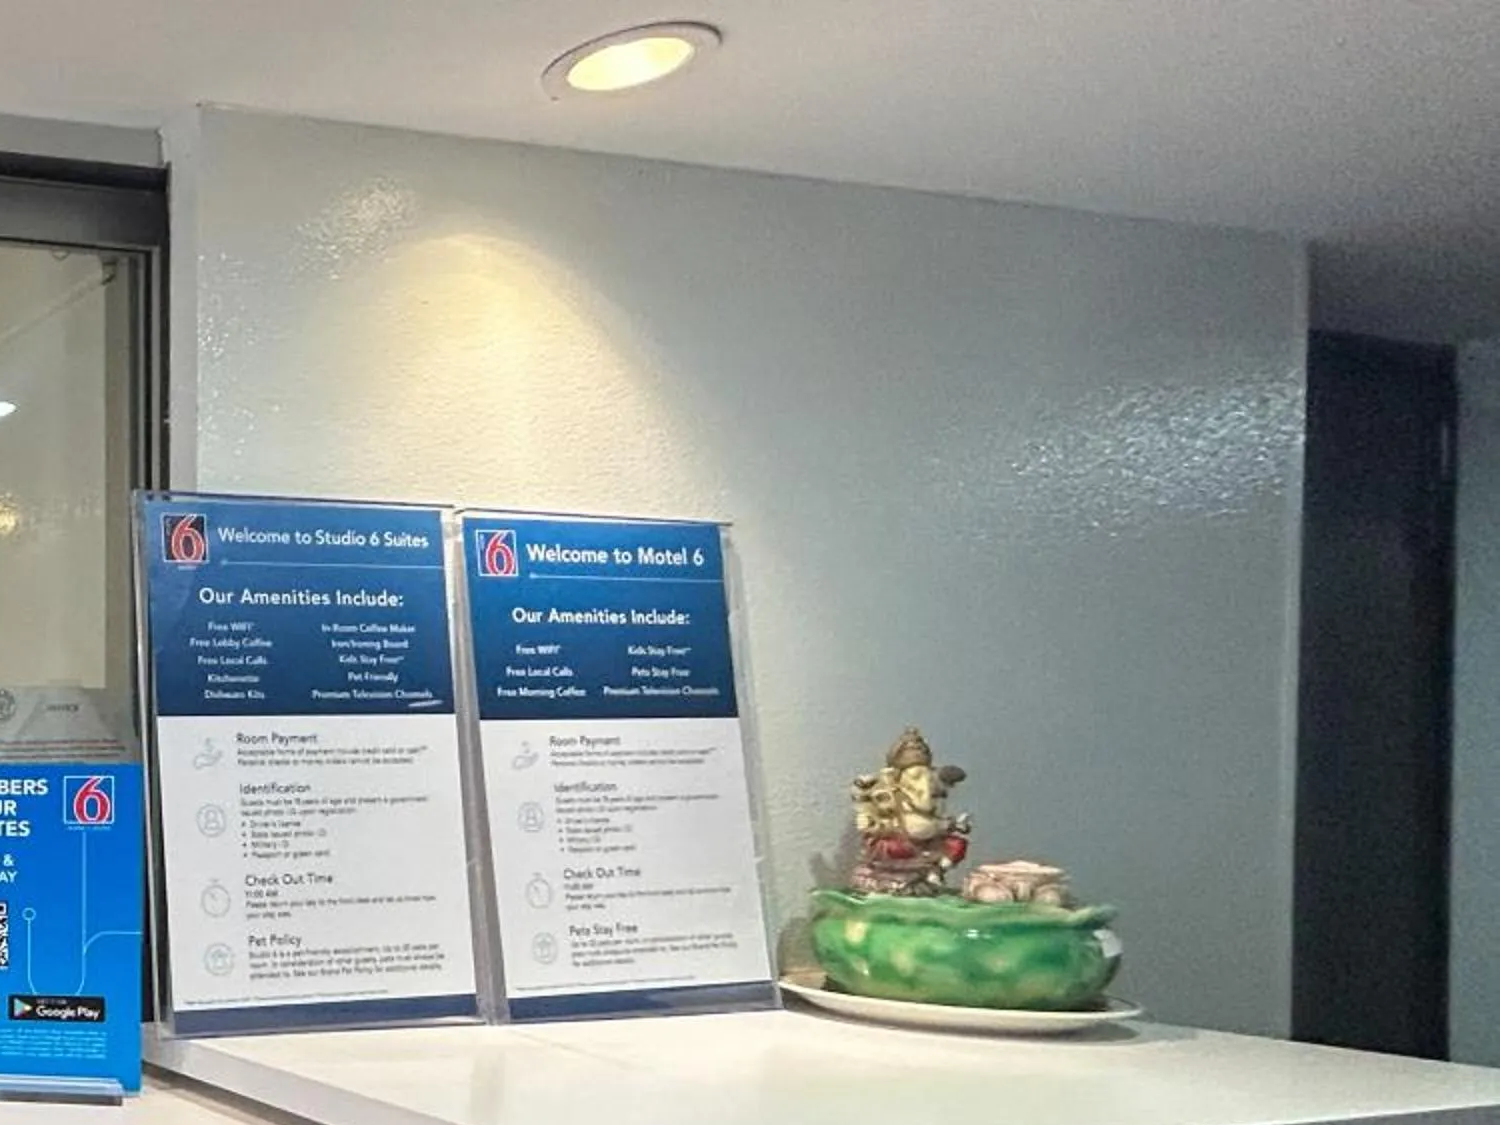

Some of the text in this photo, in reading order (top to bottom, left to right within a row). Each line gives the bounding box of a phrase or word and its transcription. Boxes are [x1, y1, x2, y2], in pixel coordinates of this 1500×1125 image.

[171, 513, 204, 563] 6
[217, 527, 429, 548] Welcome to Studio 6 Suites
[486, 530, 515, 576] 6
[525, 543, 704, 566] Welcome to Motel 6
[199, 587, 404, 607] Our Amenities Include:
[512, 607, 691, 625] Our Amenities Include:
[207, 622, 229, 631] Free
[360, 623, 389, 633] Coffee
[189, 637, 273, 649] Free Lobby Coffee
[515, 643, 536, 655] Free
[197, 655, 267, 665] Free Local Calls
[347, 671, 399, 683] Pet Friendly
[505, 665, 574, 676] Free Local Calls
[395, 688, 433, 699] Channels
[497, 685, 517, 697] Free
[556, 685, 587, 697] Coffee
[236, 732, 317, 746] Room Payment
[549, 735, 621, 748] Room Payment
[239, 782, 311, 794] Identification
[554, 781, 618, 792] Identification
[73, 776, 111, 824] 6
[3, 854, 14, 867] &
[245, 872, 333, 886] Check Out Time
[563, 865, 641, 880] Check Out Time
[569, 922, 638, 937] Pets Stay Free
[248, 933, 302, 947] Pet Policy
[36, 1006, 100, 1020] Google Play
